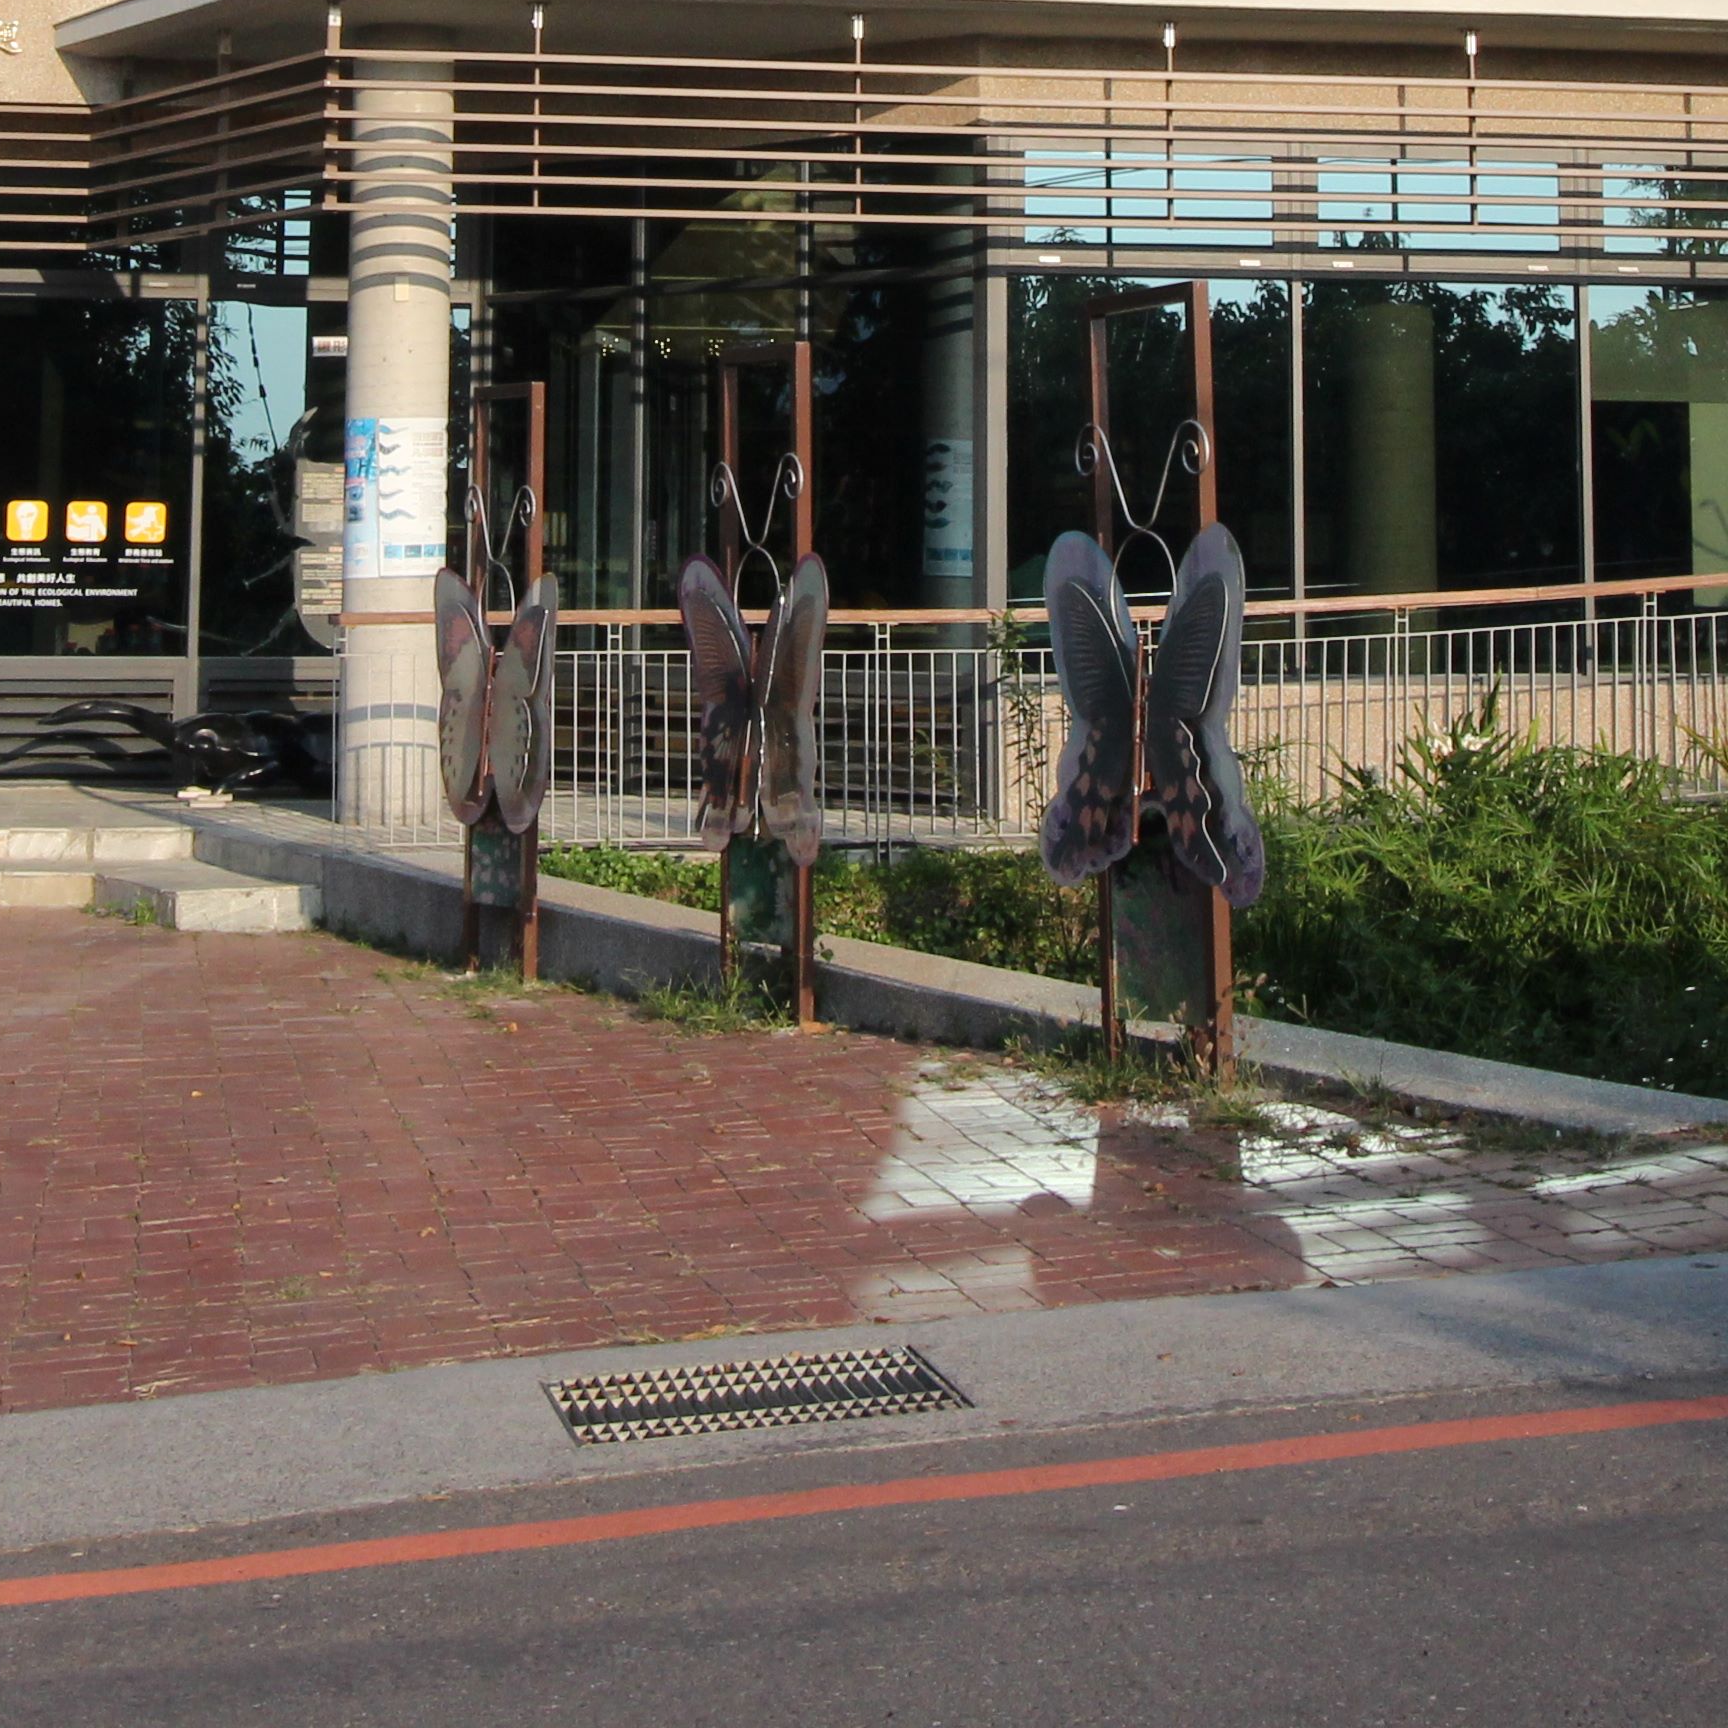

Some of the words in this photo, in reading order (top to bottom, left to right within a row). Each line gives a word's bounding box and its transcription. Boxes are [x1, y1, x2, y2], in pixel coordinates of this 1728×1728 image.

[8, 587, 20, 596] OF
[21, 588, 36, 596] THE
[37, 588, 83, 597] ECOLOGICAL
[84, 588, 138, 597] ENVIRONMENT
